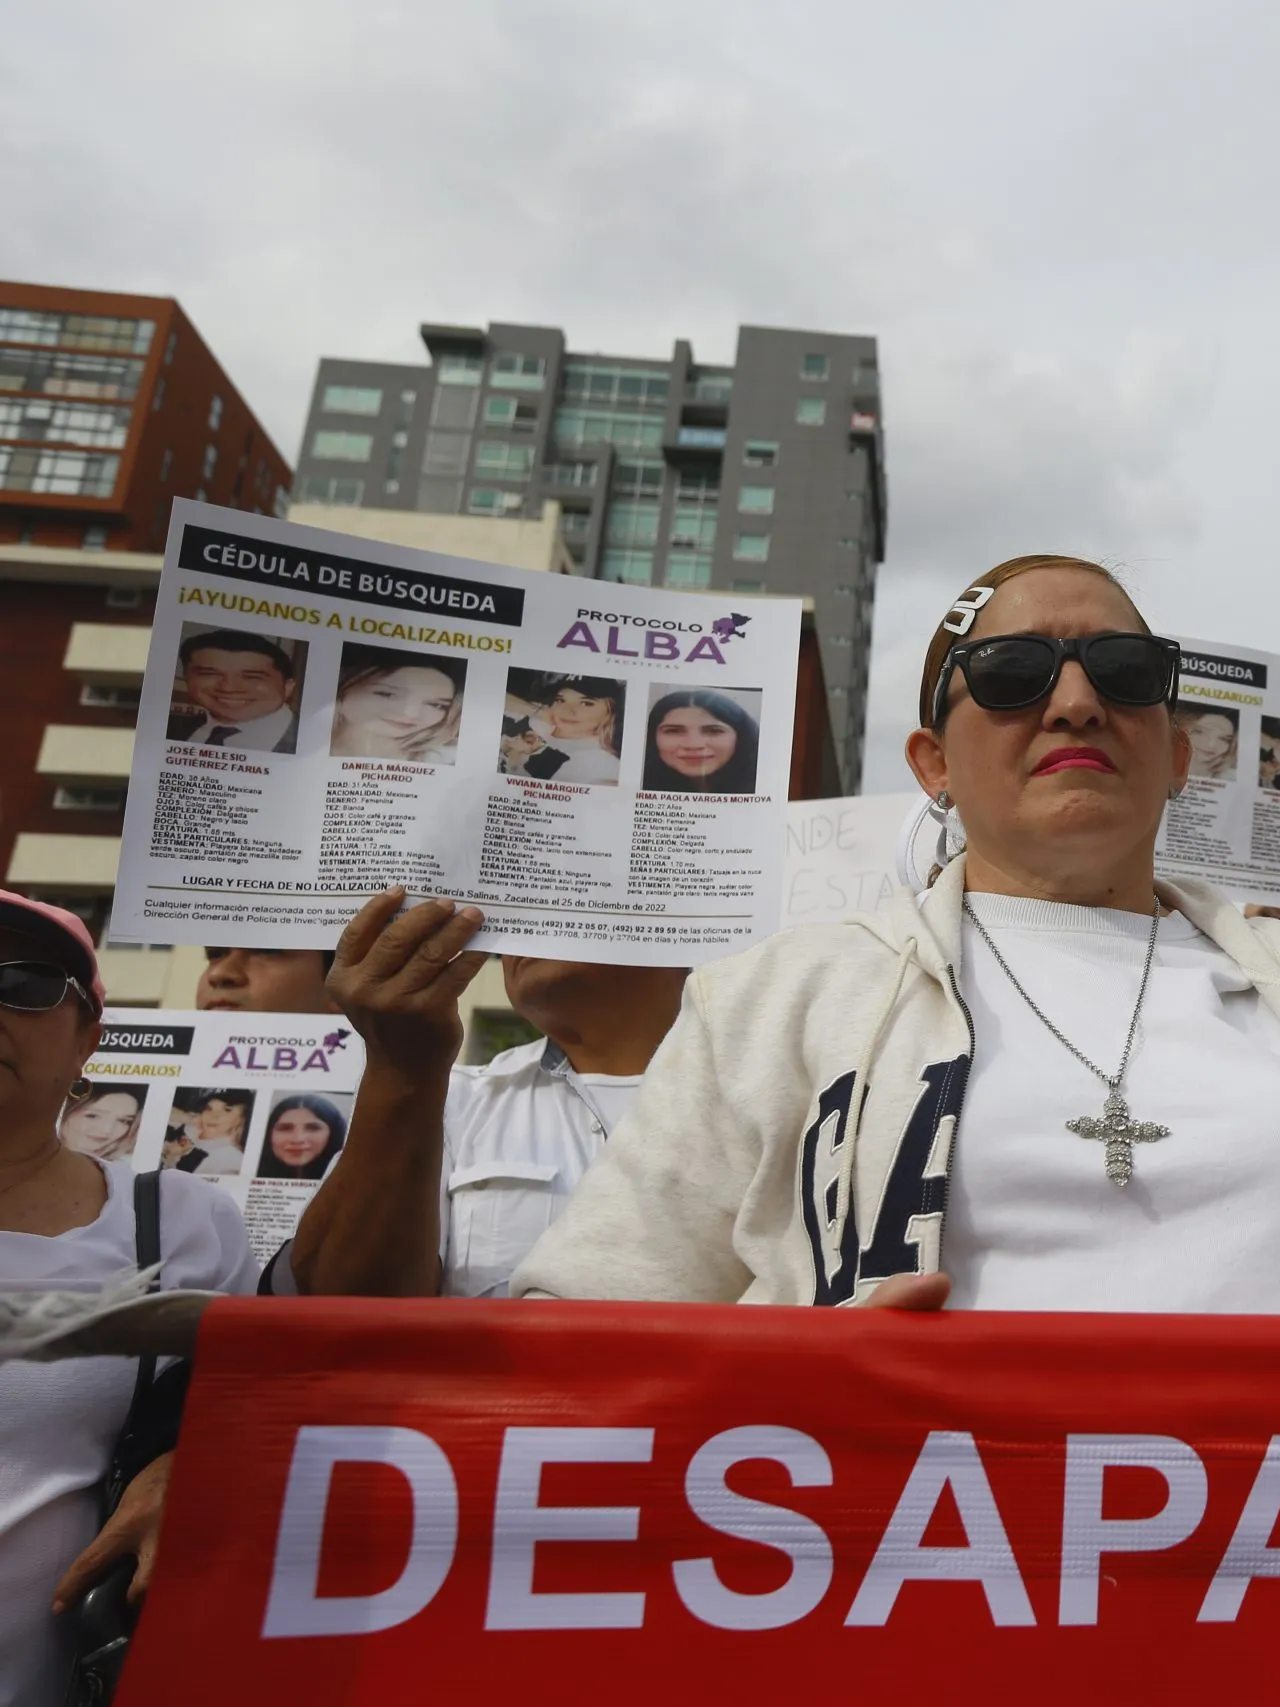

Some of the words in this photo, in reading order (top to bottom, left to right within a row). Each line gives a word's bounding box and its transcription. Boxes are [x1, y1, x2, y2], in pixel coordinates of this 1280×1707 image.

[203, 544, 310, 581] CÉDULA
[319, 565, 352, 588] DE
[358, 574, 496, 614] BÚSQUEDA
[178, 587, 321, 625] ¡AYUDANOS
[326, 614, 343, 629] A
[349, 616, 512, 654] LOCALIZARLOS!
[577, 609, 702, 633] PROTOCOLO
[556, 621, 726, 664] ALBA
[167, 746, 198, 755] JOSÉ
[199, 749, 247, 761] MELESIO
[166, 756, 228, 770] GUTIÉRREZ
[231, 765, 269, 775] FARIAS
[342, 762, 383, 771] DANIELA
[362, 773, 412, 783] PICHARDO
[507, 778, 542, 789] VIVIANA
[524, 790, 571, 802] PICHARDO
[636, 792, 657, 800] IRMA
[661, 794, 690, 802] PAOLA
[692, 795, 728, 803] VARGAS
[786, 808, 857, 855] NDE
[183, 876, 223, 886] LUGAR
[226, 878, 233, 887] Y
[237, 879, 274, 889] FECHA
[278, 881, 292, 890] DE
[295, 881, 311, 890] NO
[314, 881, 391, 892] LOCALIZACIÓN:
[421, 885, 432, 893] de
[435, 887, 464, 897] García
[504, 894, 549, 905] Zacatecas
[552, 898, 560, 906] el
[562, 898, 572, 906] 25
[575, 899, 586, 907] de
[588, 901, 630, 911] Diciembre
[633, 903, 643, 911] de
[645, 904, 666, 912] 2022
[145, 899, 191, 911] Cualquier
[194, 902, 249, 913] información
[251, 905, 303, 914] relacionada
[306, 907, 323, 915] con
[144, 910, 189, 919] Dirección
[192, 912, 229, 921] General
[232, 913, 244, 922] de
[280, 916, 291, 924] de
[488, 916, 499, 924] los
[502, 918, 539, 927] teléfonos
[542, 919, 563, 929] (492)
[612, 925, 633, 934] (492)
[679, 927, 688, 935] de
[703, 927, 731, 935] oficinas
[734, 927, 743, 935] de
[493, 925, 509, 934] 345
[511, 926, 521, 935] 29
[523, 927, 534, 935] 96
[655, 935, 670, 943] días
[680, 936, 700, 944] horas
[100, 1030, 174, 1048] ÚSQUEDA
[229, 1036, 316, 1047] PROTOCOLO
[212, 1046, 330, 1072] ALBA
[84, 1062, 182, 1077] OCALIZARLOS!
